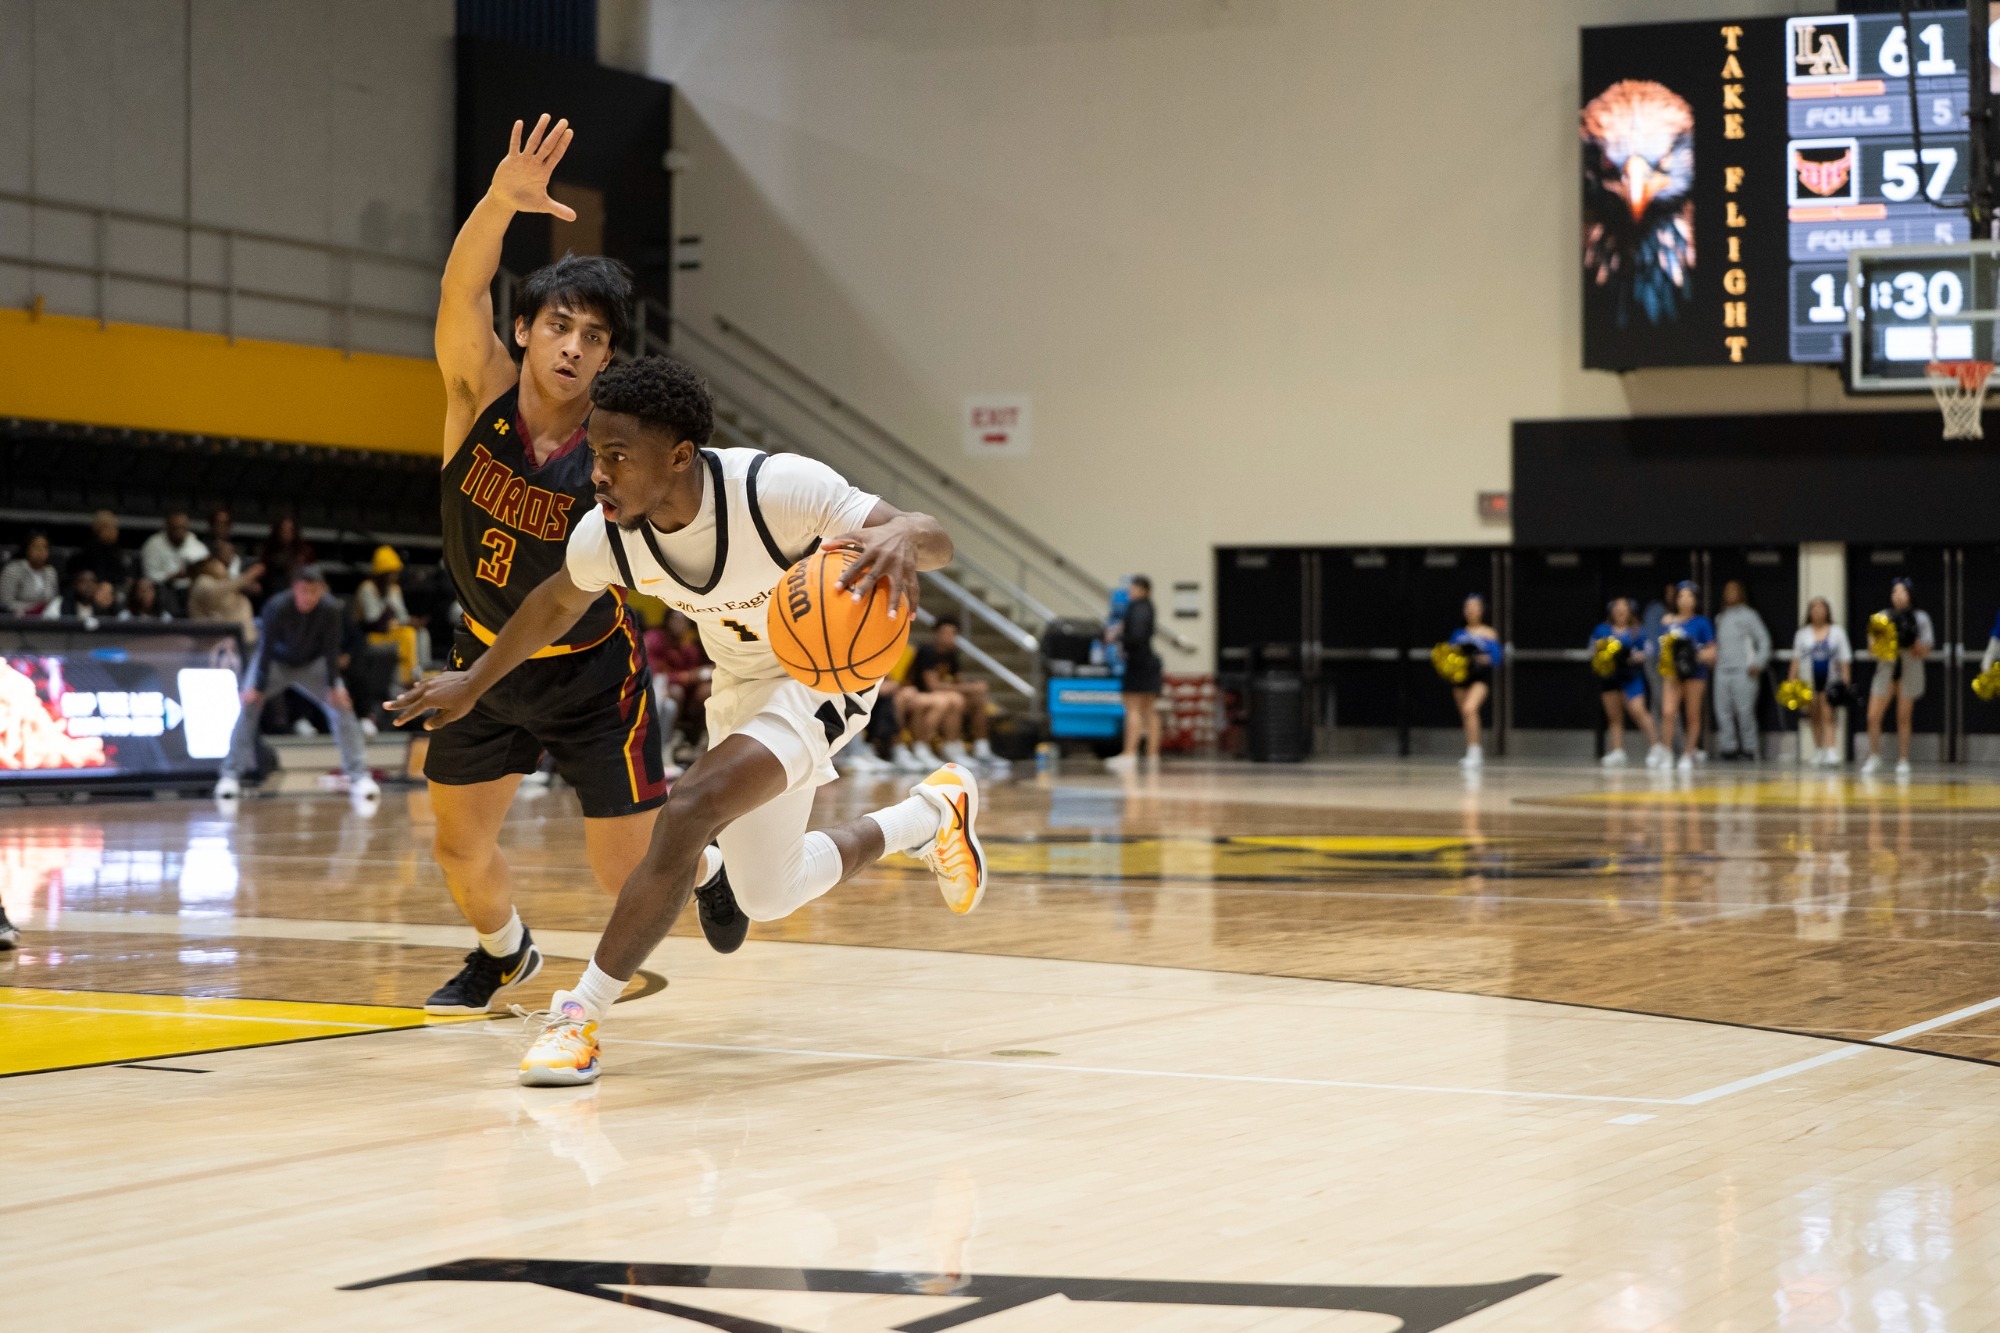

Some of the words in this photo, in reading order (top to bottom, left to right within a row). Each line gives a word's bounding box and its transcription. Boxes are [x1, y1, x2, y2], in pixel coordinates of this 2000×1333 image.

[1795, 25, 1849, 75] LA
[1879, 24, 1956, 77] 61
[1721, 25, 1746, 139] TAKE
[1806, 104, 1892, 129] FOULS
[1932, 98, 1952, 126] 5
[1880, 148, 1957, 201] 57
[1723, 166, 1747, 363] FLIGHT
[1806, 228, 1893, 251] FOULS
[972, 406, 1019, 428] EXIT
[460, 443, 576, 541] TOROS
[475, 528, 516, 587] 3
[787, 557, 811, 623] Wils
[721, 618, 760, 641] 1
